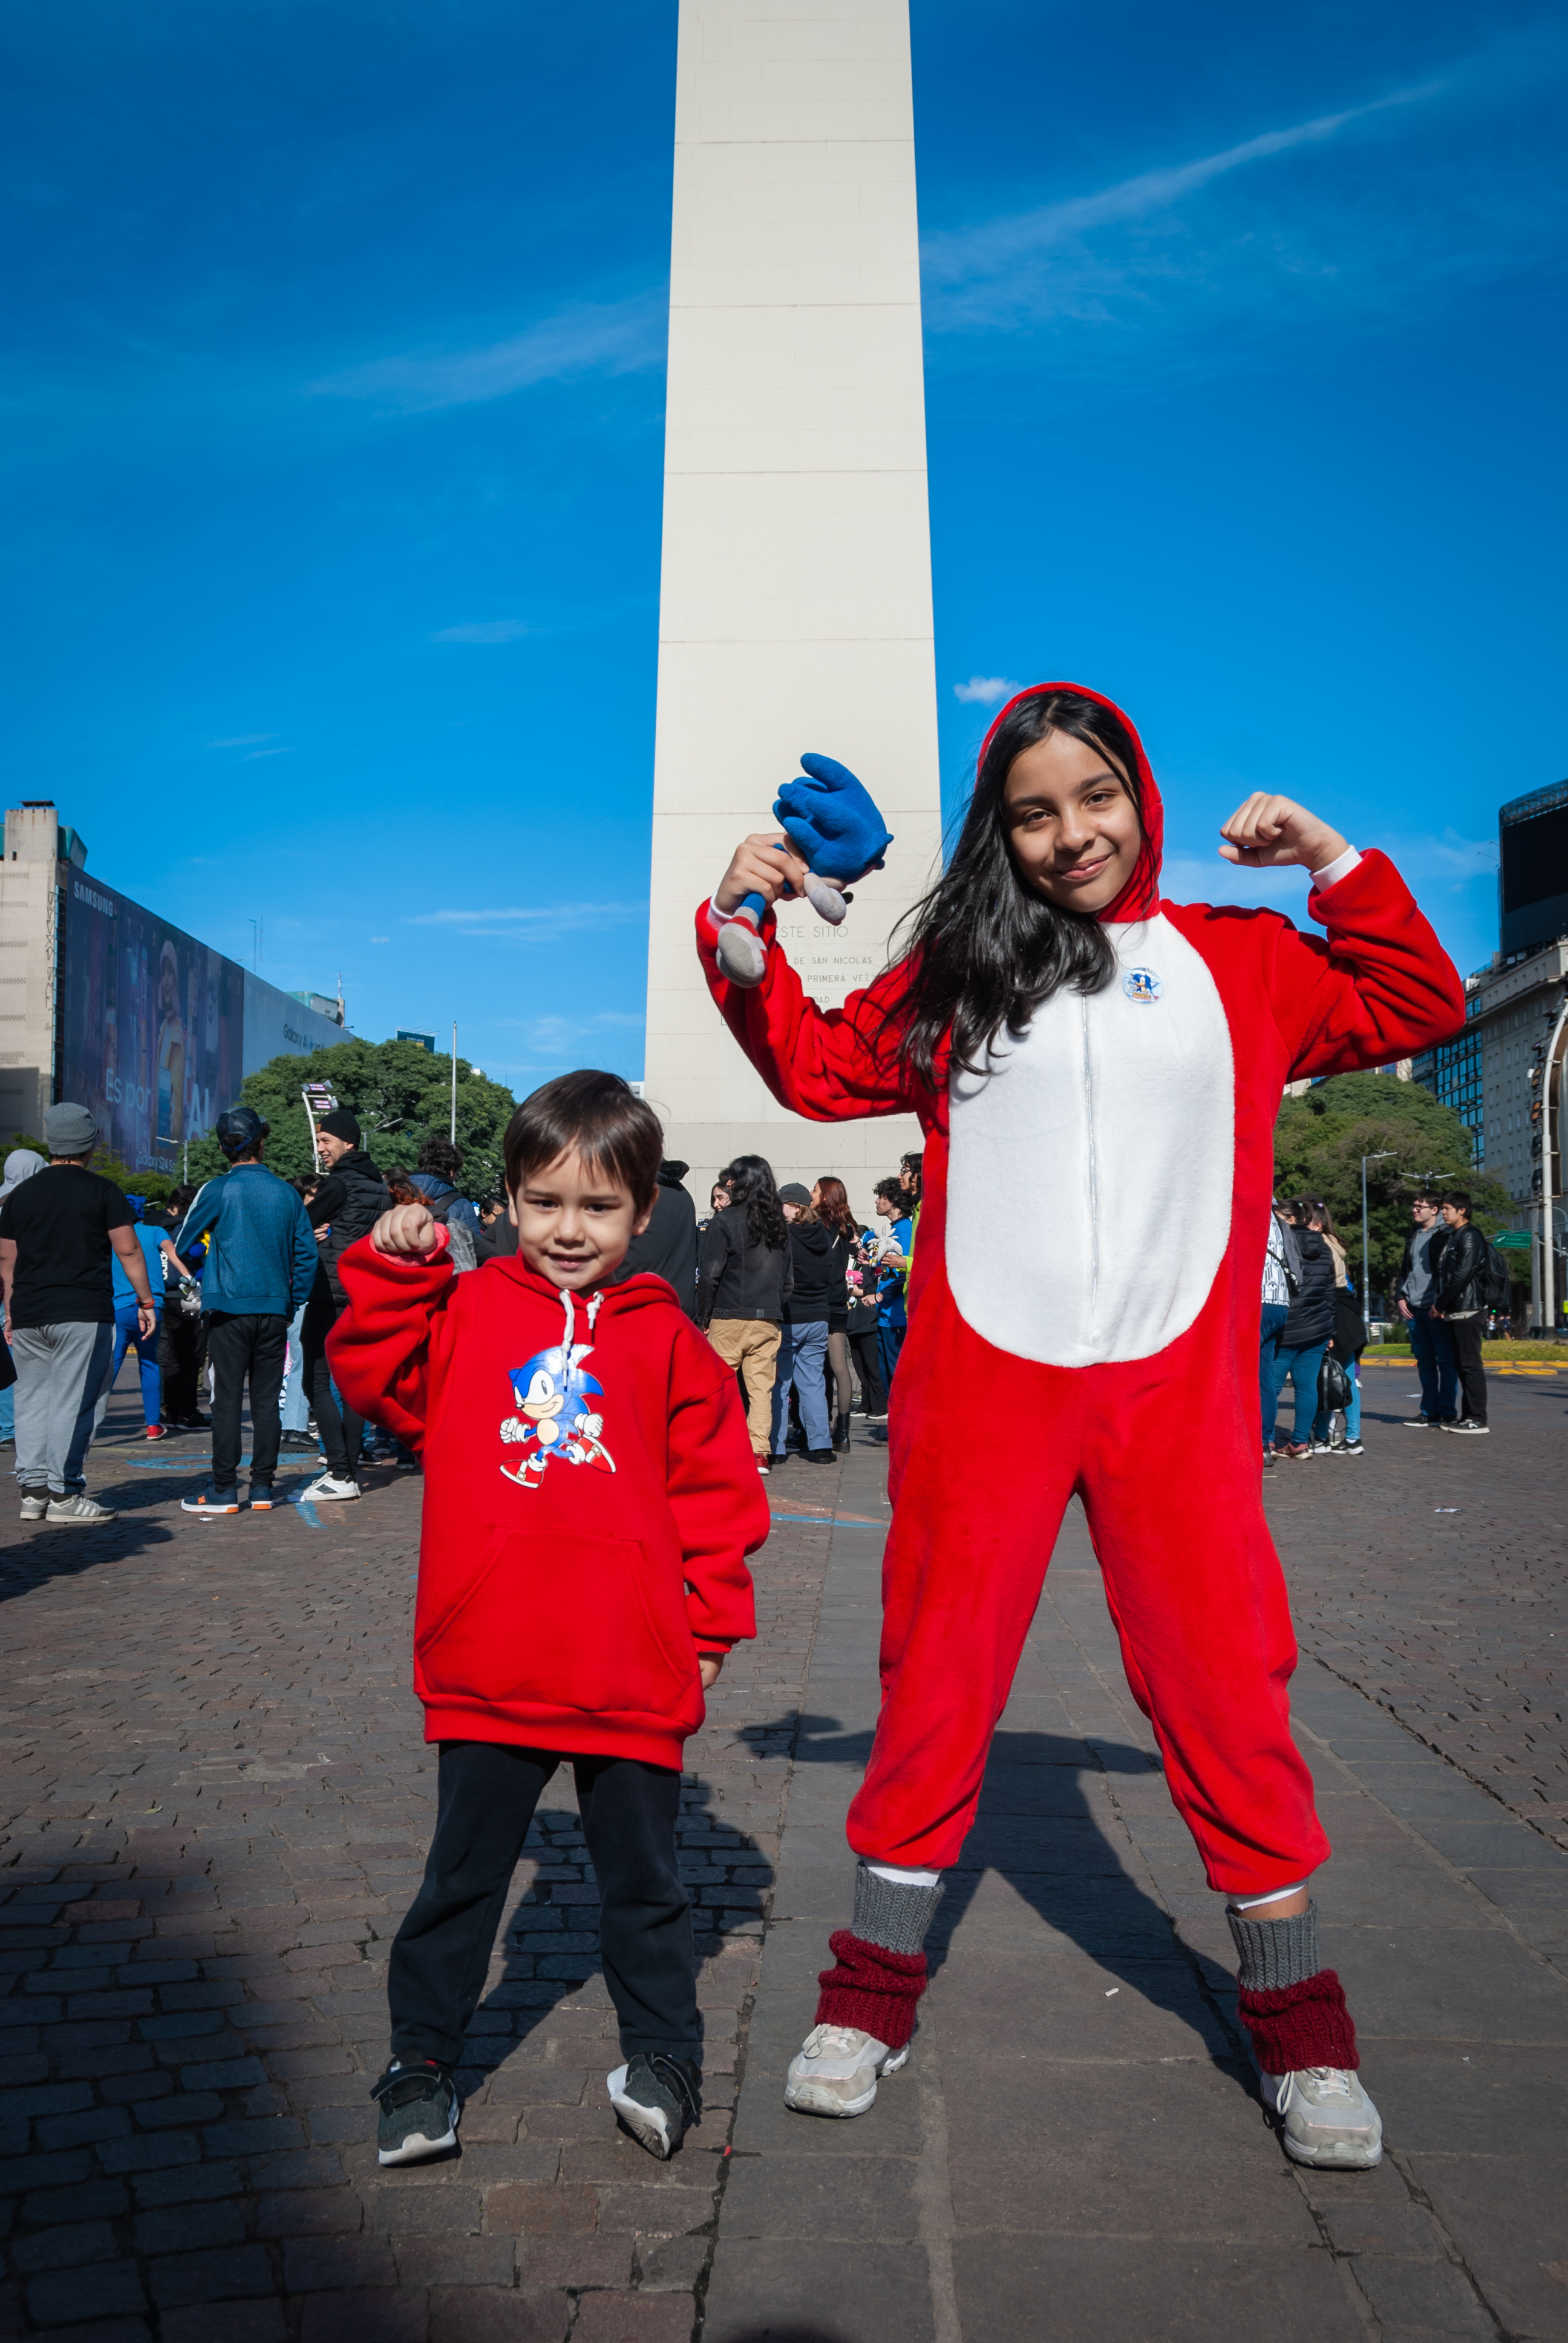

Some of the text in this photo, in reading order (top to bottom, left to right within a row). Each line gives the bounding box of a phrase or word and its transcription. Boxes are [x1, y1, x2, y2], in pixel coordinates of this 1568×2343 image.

[74, 881, 113, 917] SAMSUNG
[814, 926, 848, 937] SITIO
[283, 1023, 308, 1051] Galaxy AI
[106, 1068, 209, 1141] Es por AI
[138, 1151, 158, 1172] Galaxy
[159, 1156, 168, 1171] S24
